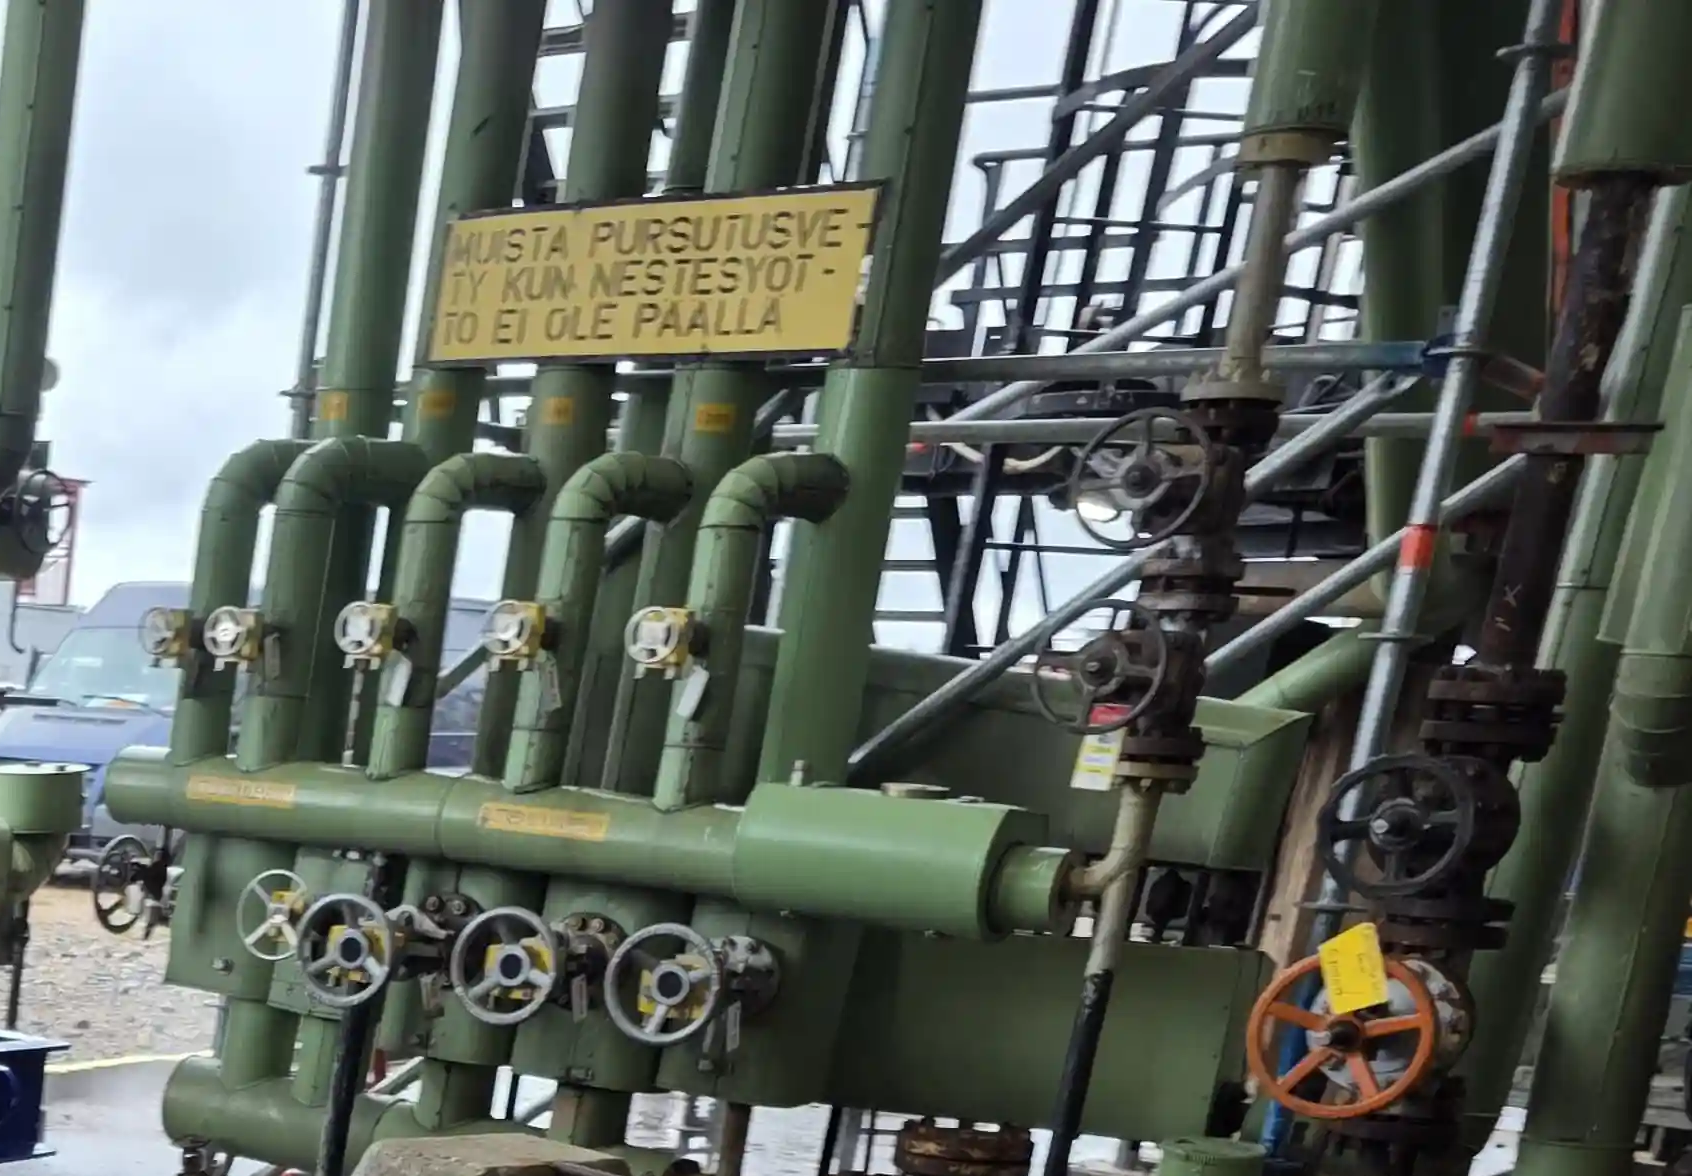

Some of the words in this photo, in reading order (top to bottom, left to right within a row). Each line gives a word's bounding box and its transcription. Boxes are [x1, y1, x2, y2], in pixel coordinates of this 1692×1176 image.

[453, 225, 568, 266] MUISTA
[450, 270, 487, 305] TY
[501, 264, 575, 304] KUN
[491, 308, 529, 345] EI
[544, 304, 618, 341] OLE
